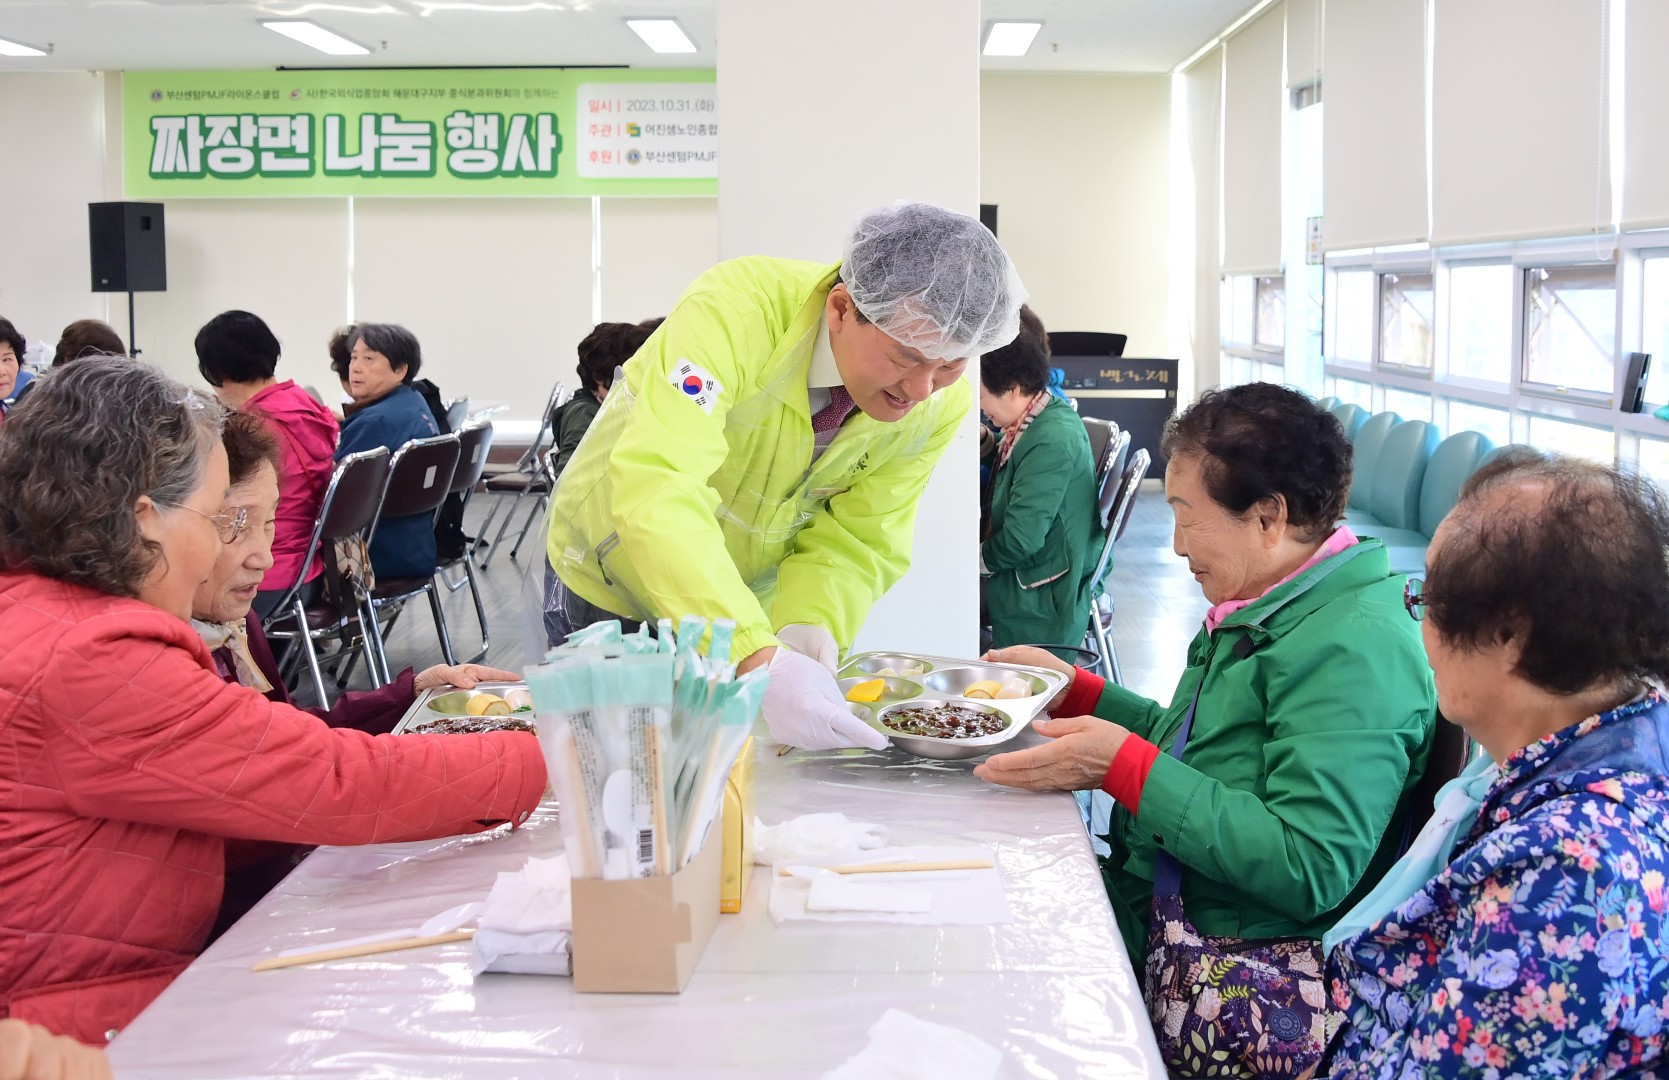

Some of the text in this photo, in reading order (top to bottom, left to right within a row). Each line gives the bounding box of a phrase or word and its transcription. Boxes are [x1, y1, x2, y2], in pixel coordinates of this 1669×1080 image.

[588, 99, 715, 113] 일시 2023.10.31.(화)
[588, 123, 718, 137] 주관 어진샘노인종합
[150, 111, 562, 180] 짜장면 나눔 행사
[588, 150, 612, 164] 후원
